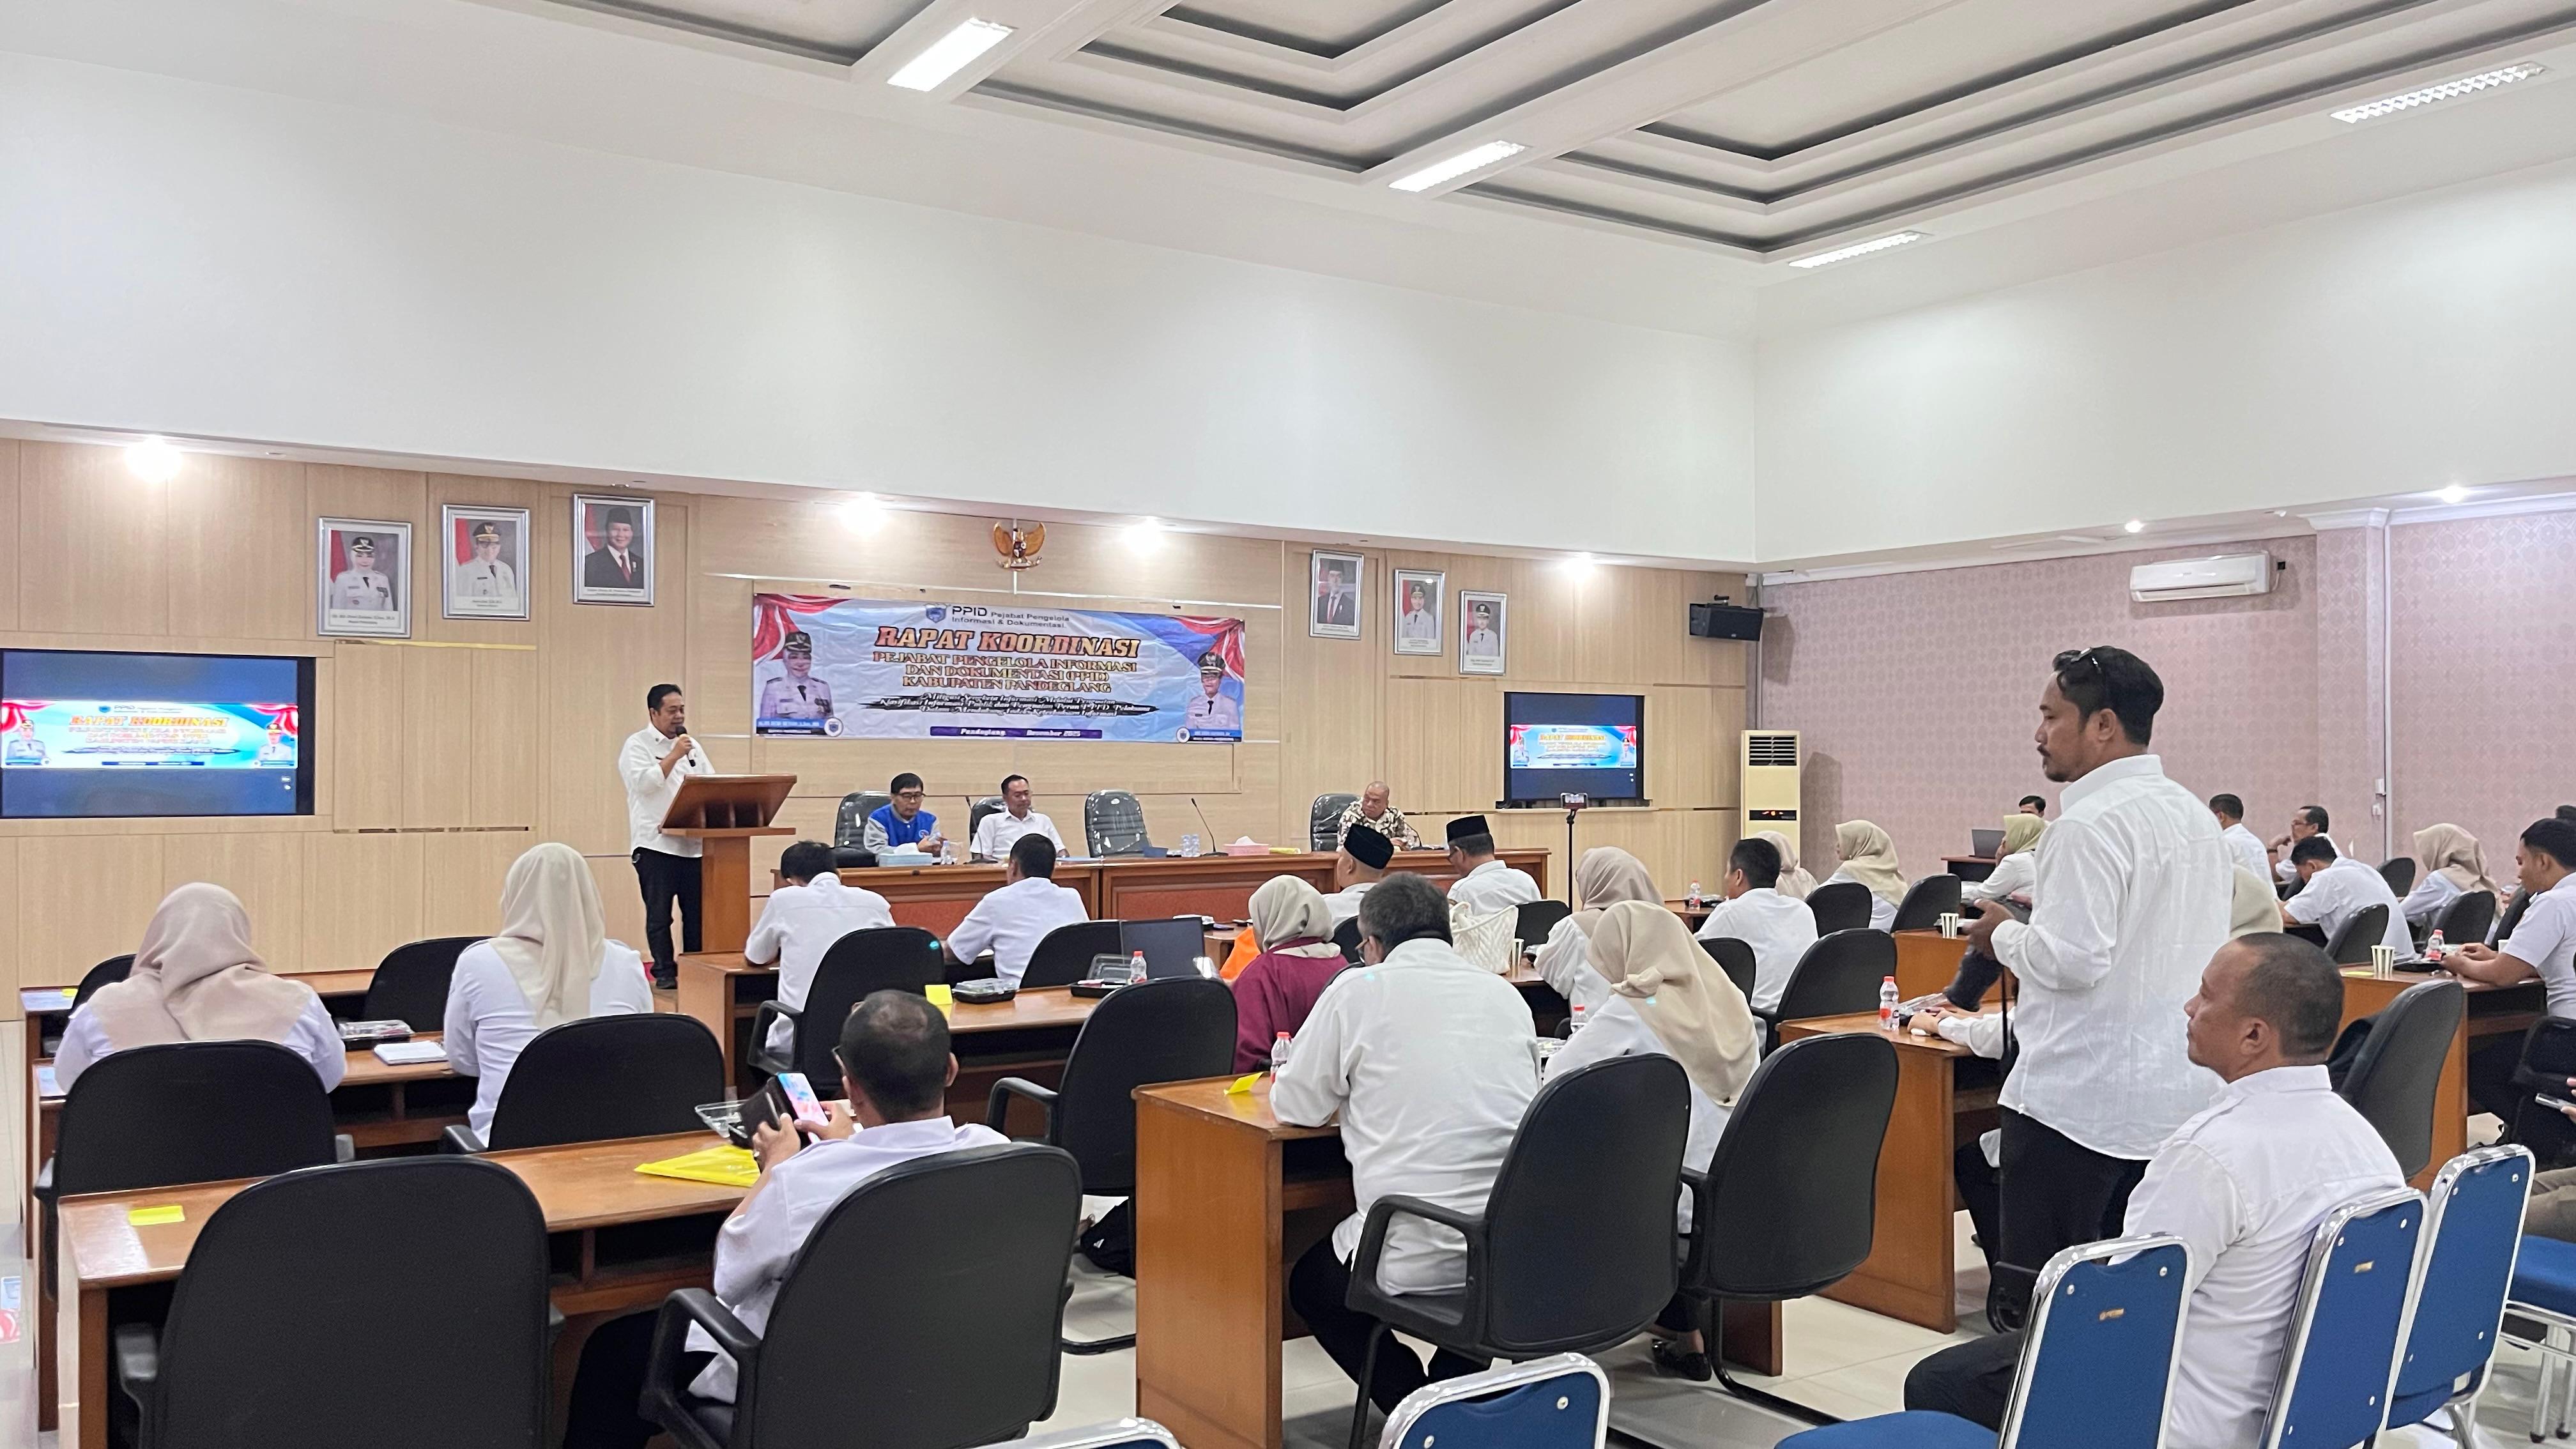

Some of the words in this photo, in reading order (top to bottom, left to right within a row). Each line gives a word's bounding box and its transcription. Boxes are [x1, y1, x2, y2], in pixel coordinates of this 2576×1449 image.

[952, 606, 987, 617] PPID
[1027, 614, 1070, 622] Pengelola
[874, 625, 976, 650] RAPAT
[977, 631, 1141, 658] KOORDINASI
[873, 651, 950, 664] PEJABAT
[952, 654, 1049, 668] PENGELOLA
[1050, 659, 1137, 671] INFORMASI
[905, 664, 942, 676] DAN
[945, 666, 1064, 680] DOKUMENTASI
[1066, 671, 1110, 682] (PPID)
[902, 676, 1003, 689] KABUPATEN
[1005, 679, 1112, 693] PANDEGLANG
